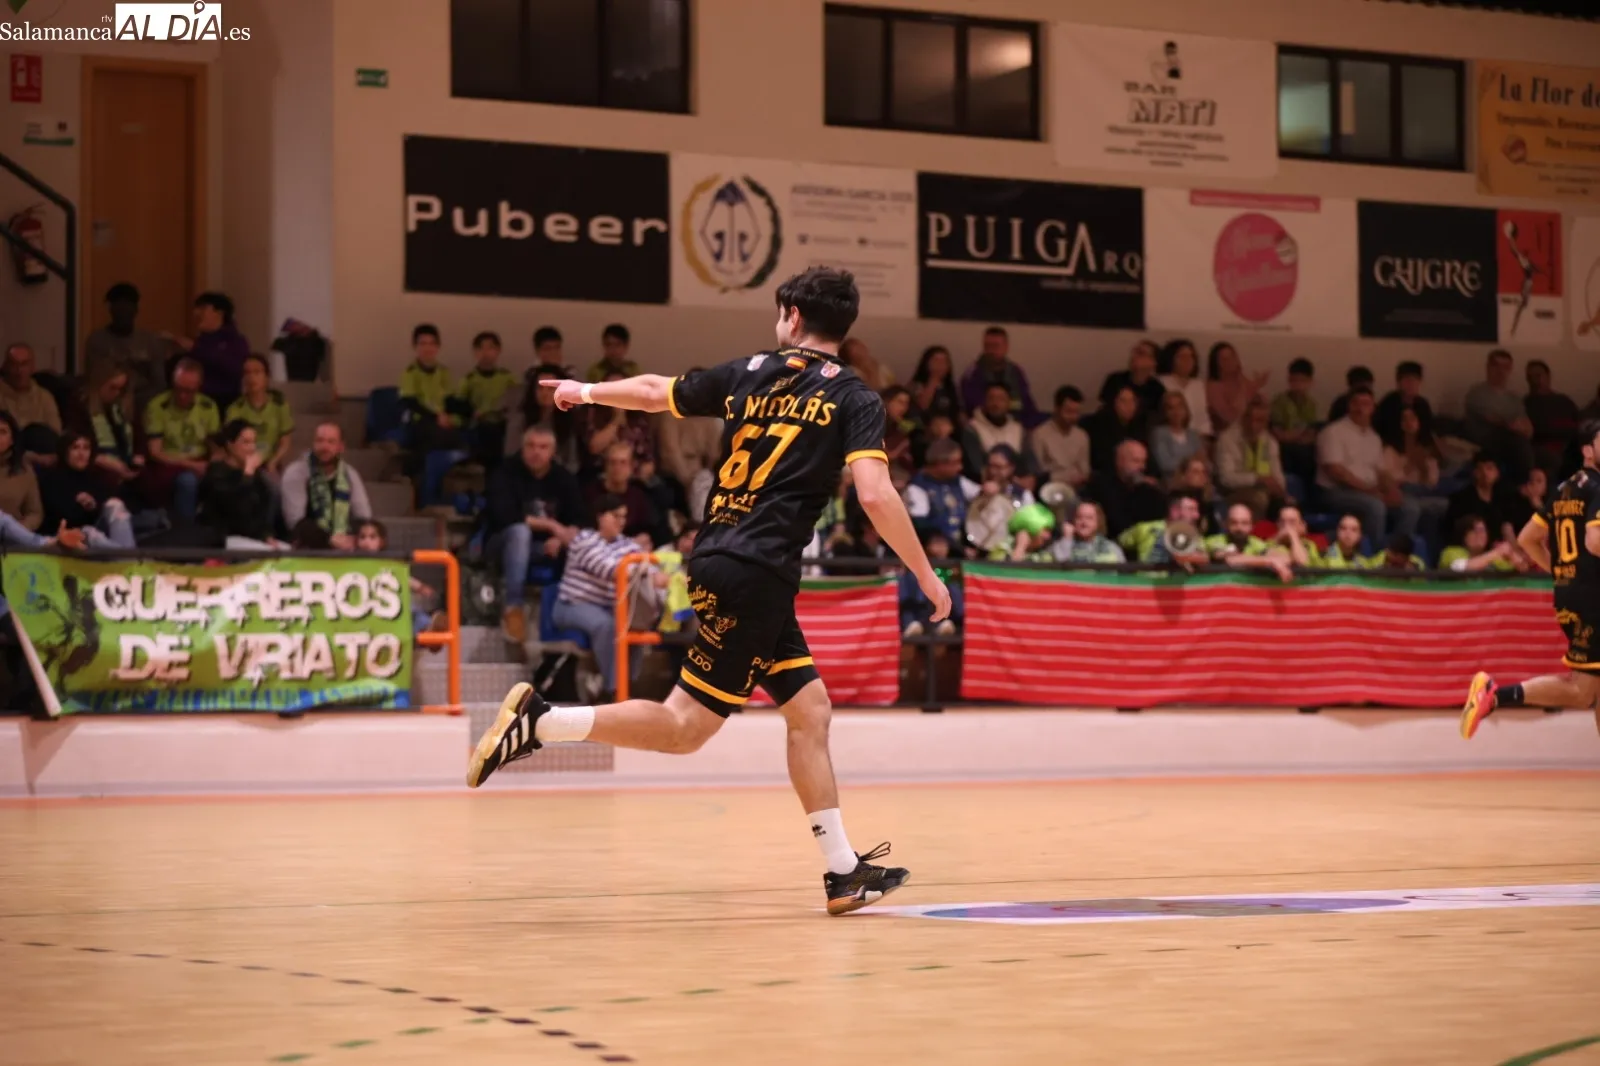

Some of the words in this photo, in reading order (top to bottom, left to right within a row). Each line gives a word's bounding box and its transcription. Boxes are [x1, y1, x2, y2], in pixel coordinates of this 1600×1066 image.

[1530, 76, 1576, 106] Flor
[406, 194, 667, 247] Pubeer
[718, 422, 803, 492] 67
[93, 570, 402, 624] GUERREROS
[117, 634, 192, 682] DE
